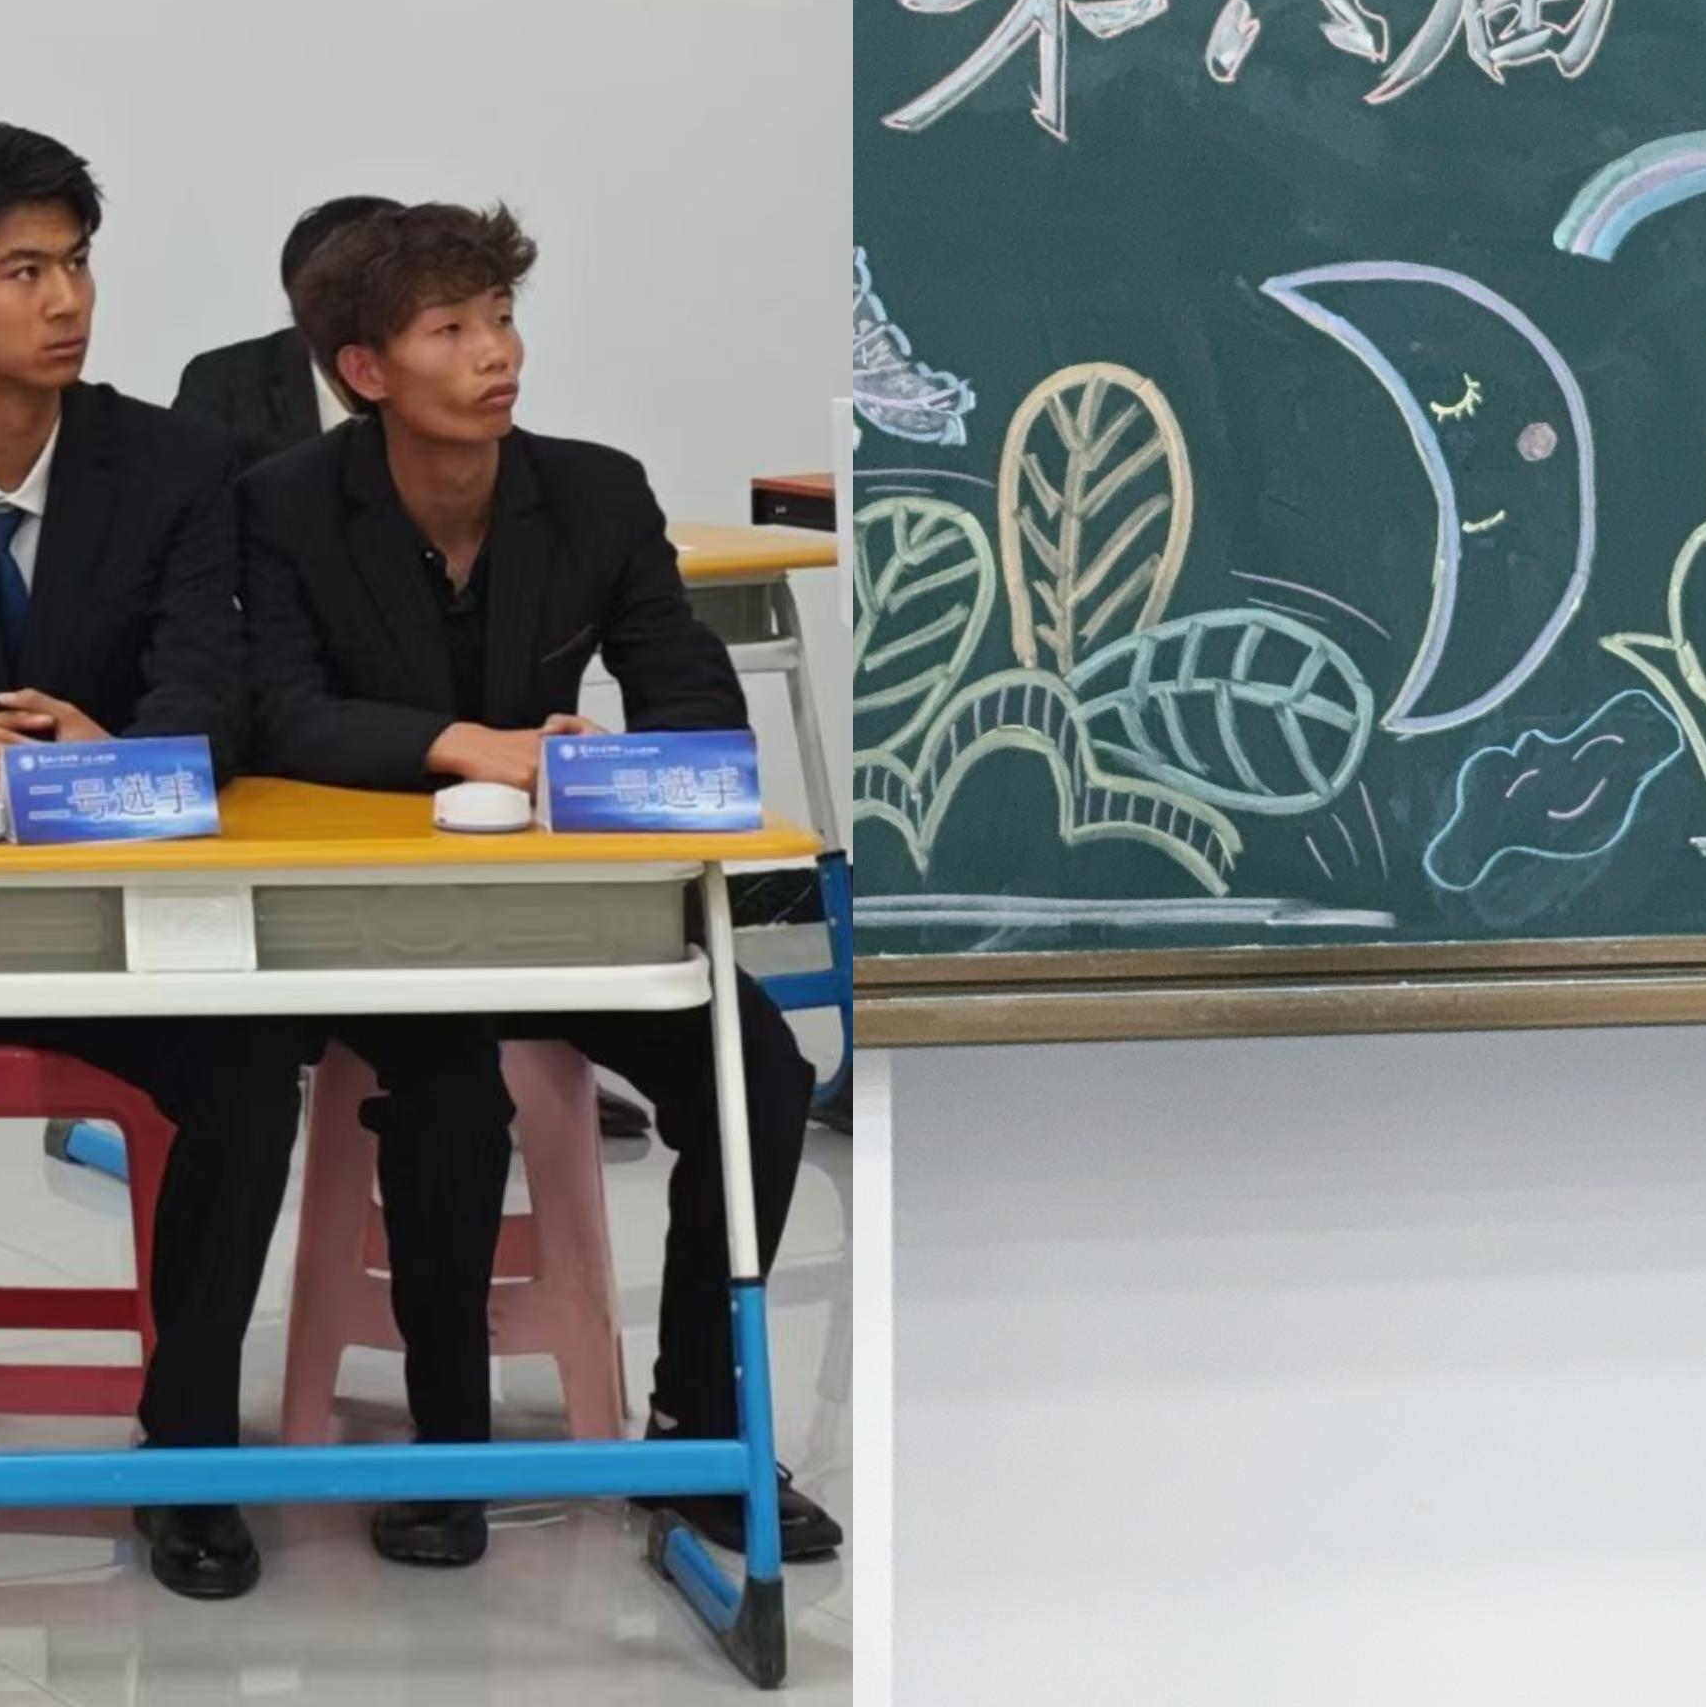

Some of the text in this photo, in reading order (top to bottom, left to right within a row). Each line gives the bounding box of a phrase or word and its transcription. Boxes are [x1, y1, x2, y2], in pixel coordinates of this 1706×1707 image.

[29, 763, 201, 822] 二号选手
[563, 760, 741, 812] 一号选手
